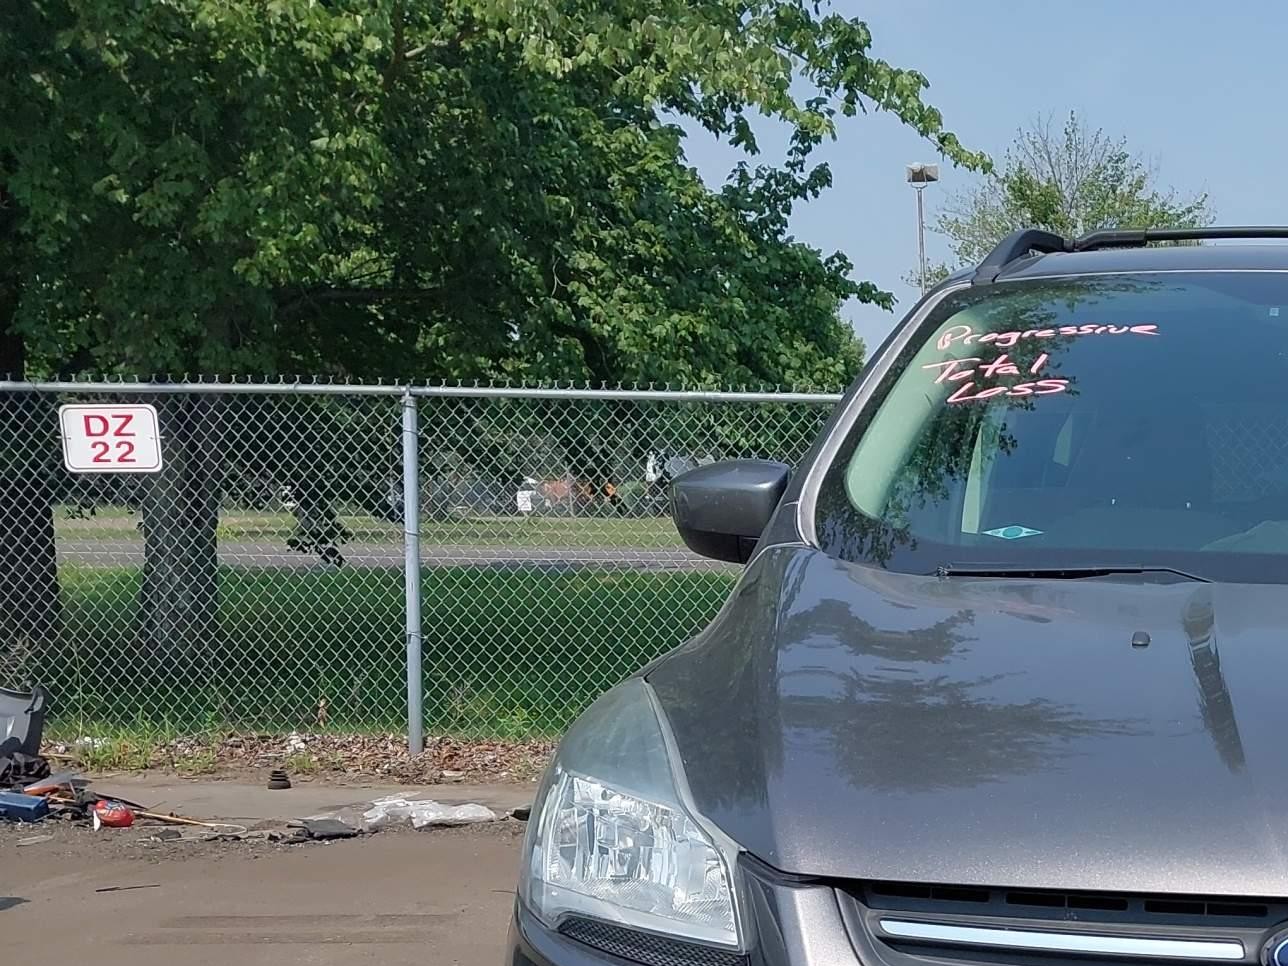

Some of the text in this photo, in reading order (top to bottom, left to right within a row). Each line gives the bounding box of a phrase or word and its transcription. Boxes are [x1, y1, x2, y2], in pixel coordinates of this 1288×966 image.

[937, 325, 1160, 350] Progressive
[922, 353, 1049, 384] Total
[946, 379, 1070, 404] Loss
[83, 414, 136, 437] DZ
[90, 440, 136, 463] 22
